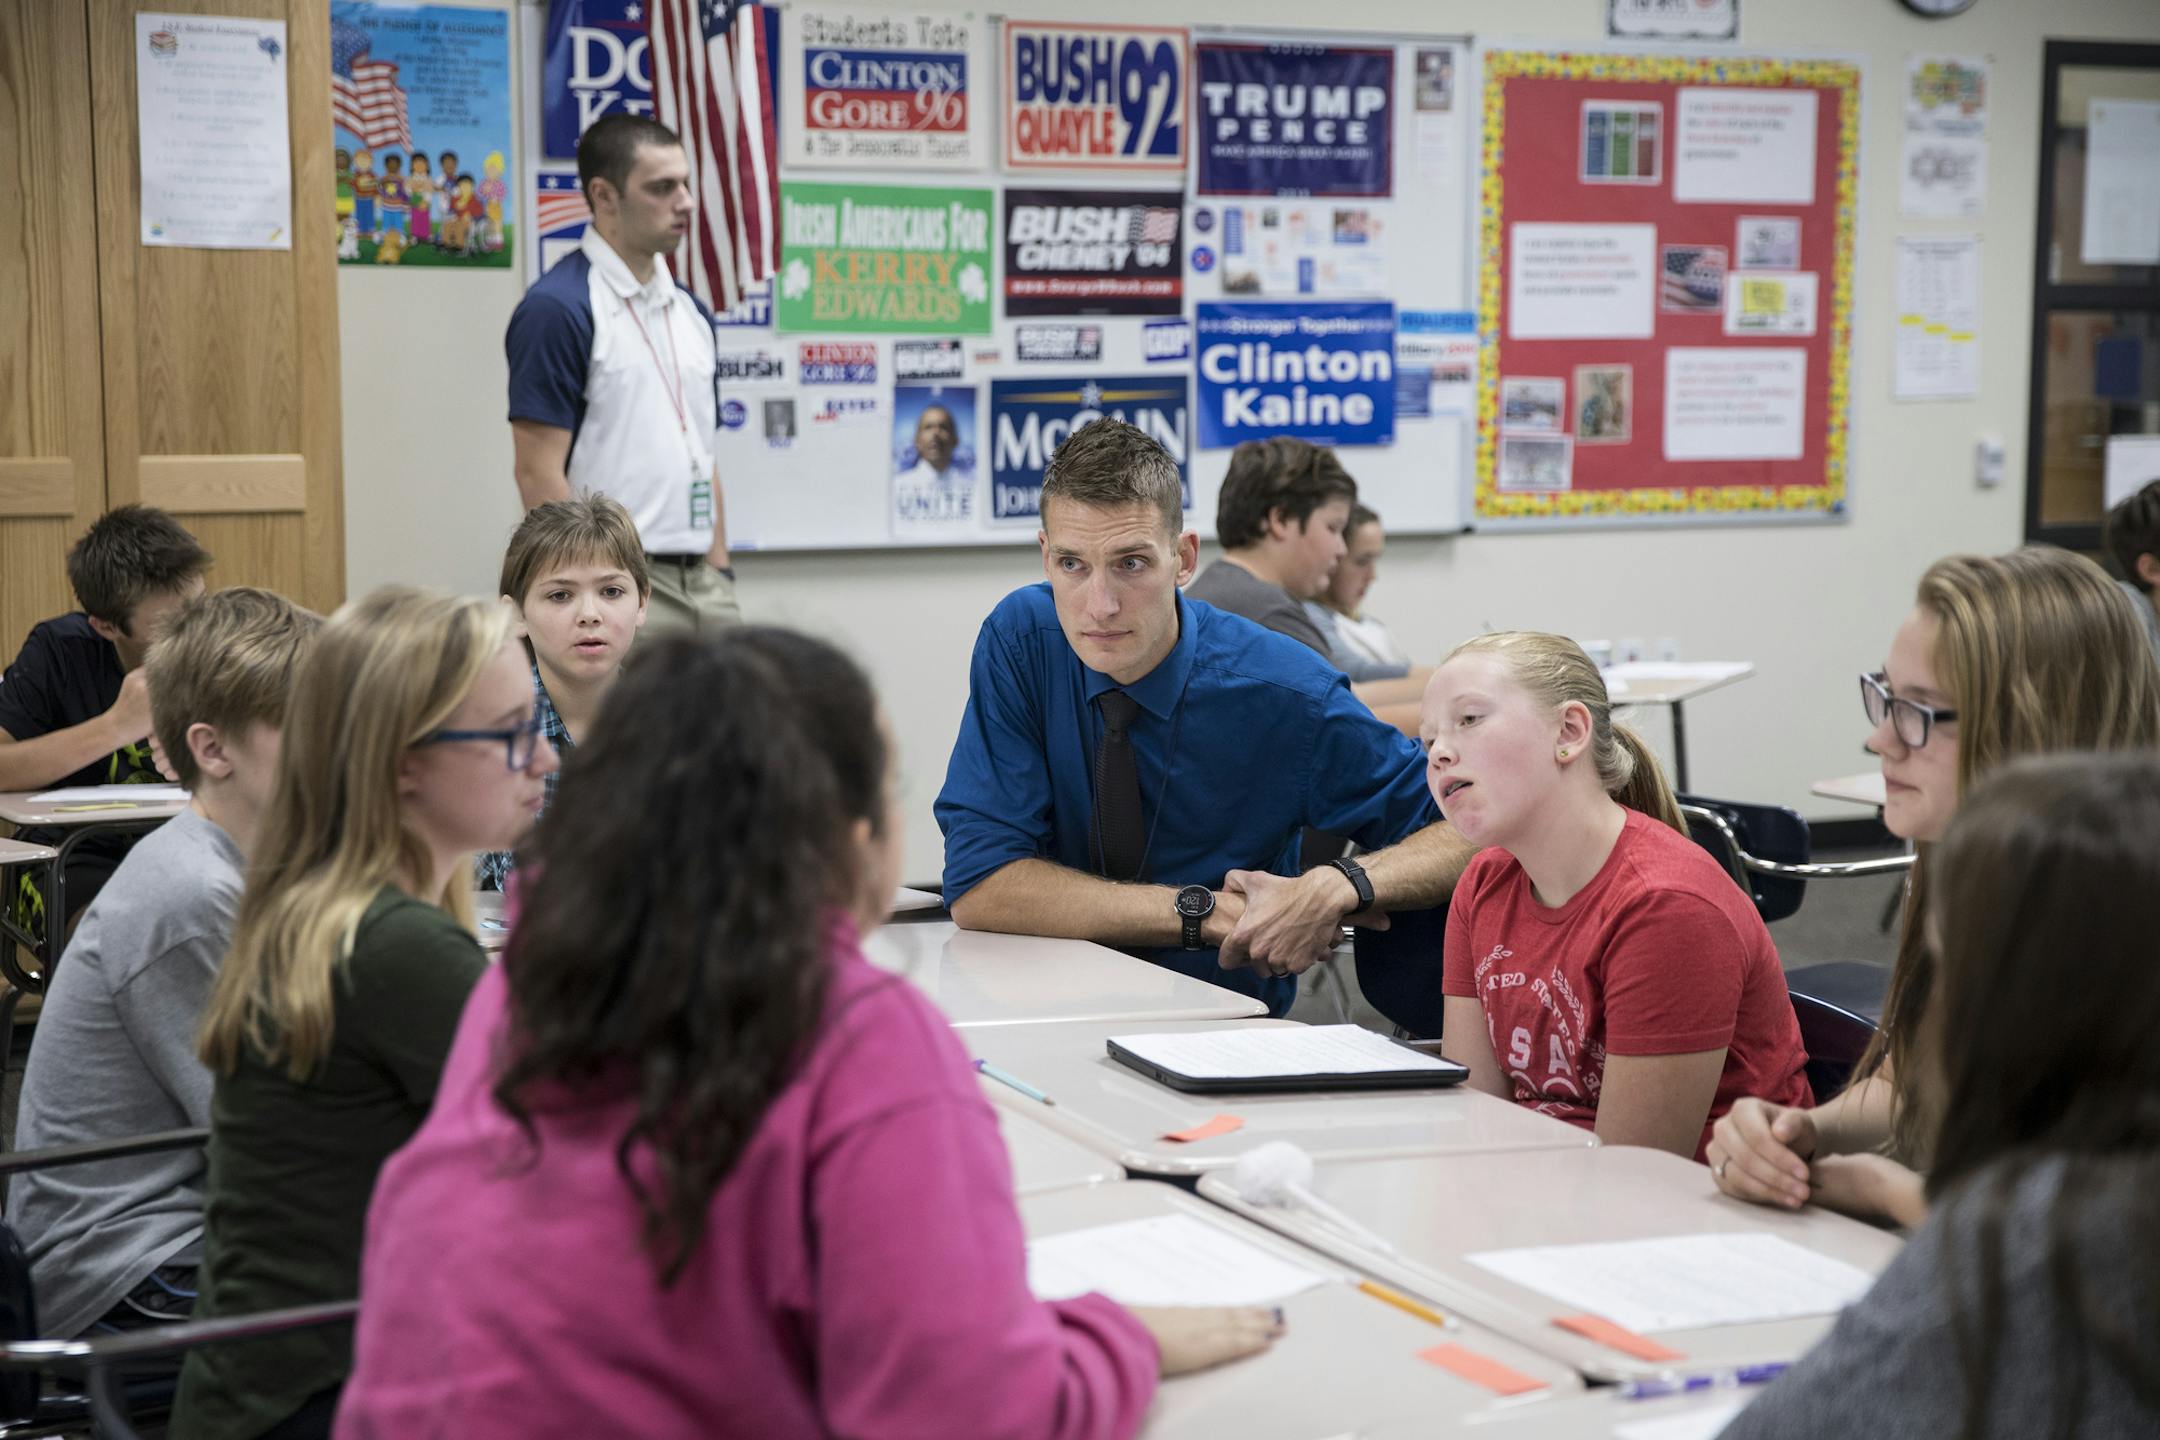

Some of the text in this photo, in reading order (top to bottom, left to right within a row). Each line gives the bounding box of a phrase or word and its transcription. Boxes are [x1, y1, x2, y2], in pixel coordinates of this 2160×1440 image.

[802, 13, 970, 46] Students Vote
[810, 51, 963, 90] CLINTON
[810, 91, 911, 130] GORE
[1016, 35, 1179, 156] BUSH 92
[1202, 82, 1386, 119] TRUMP
[1016, 108, 1116, 155] QUAYLE
[1216, 119, 1369, 145] PENCE
[785, 197, 988, 253] IRISH AMERICANS FOR
[1009, 205, 1131, 244] BUSH
[814, 250, 958, 285] KERRY
[1016, 243, 1130, 271] CHENEY
[812, 286, 960, 322] EDWARDS
[1227, 316, 1362, 338] Stronger Together
[801, 343, 876, 365] CLINTON
[1202, 342, 1392, 384] Clinton
[1223, 388, 1374, 427] Kaine
